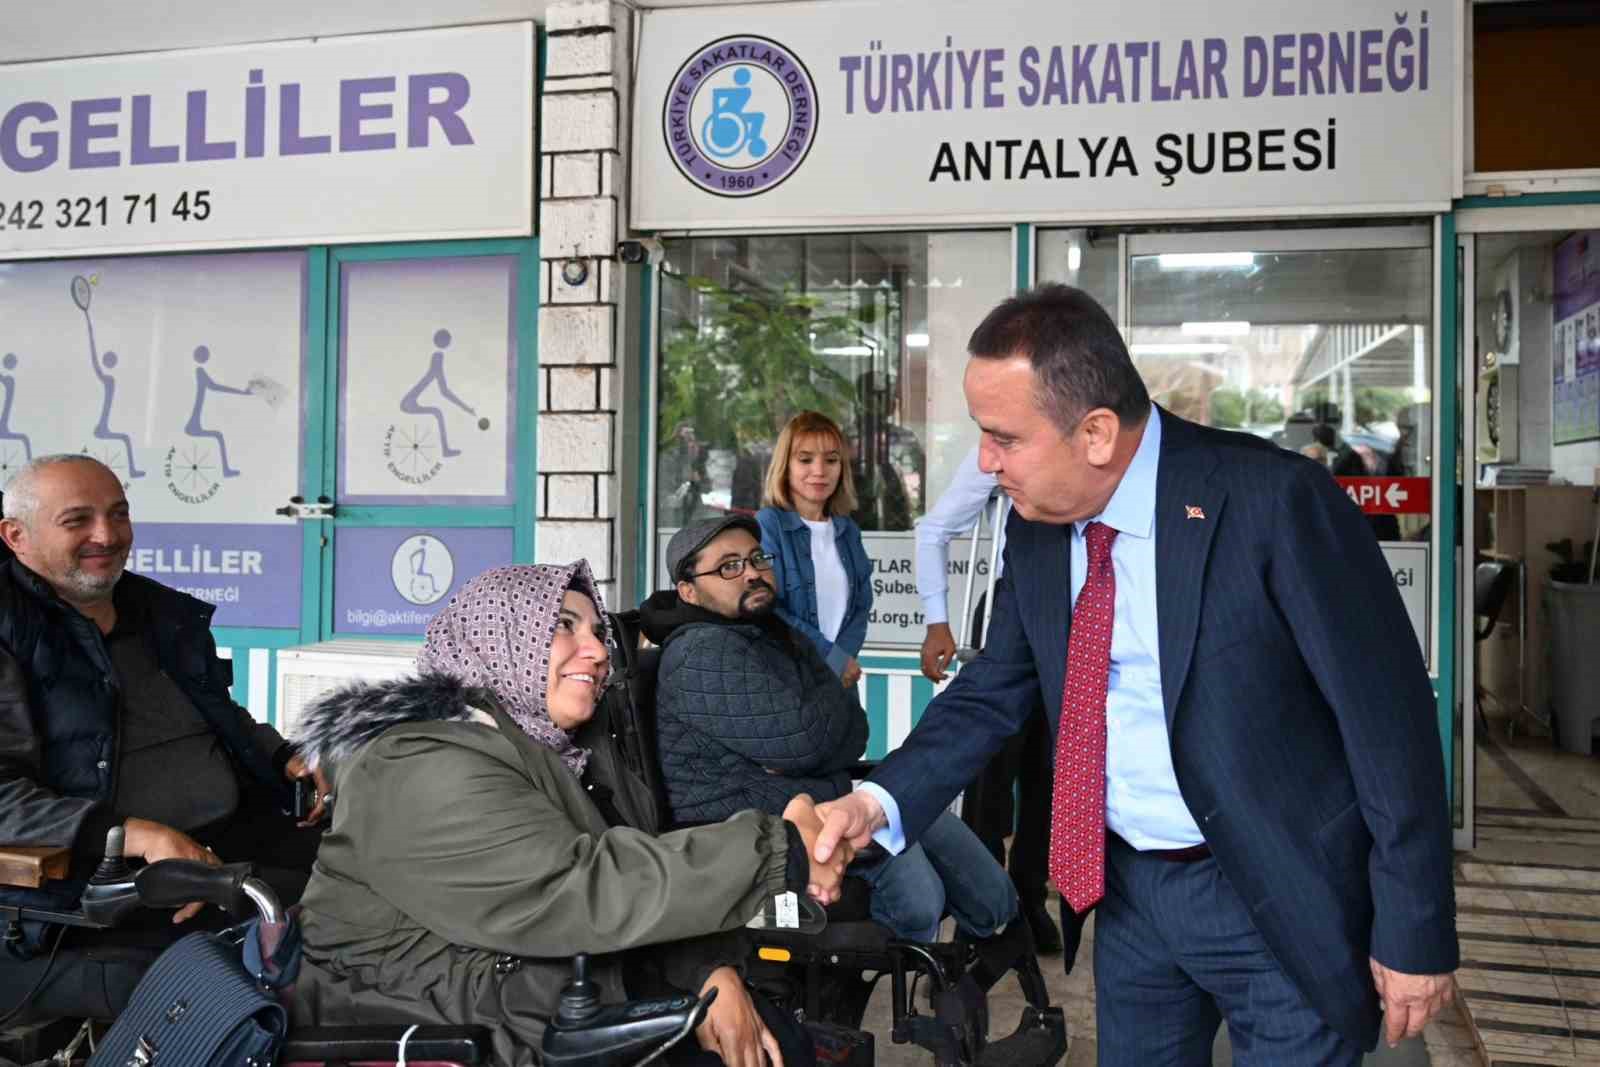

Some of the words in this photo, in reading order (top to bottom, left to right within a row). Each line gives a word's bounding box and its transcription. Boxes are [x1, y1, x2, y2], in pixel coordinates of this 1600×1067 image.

[689, 45, 787, 81] SAKATLAR
[839, 35, 1005, 114] TÜRKİYE
[1018, 38, 1228, 107] SAKATLAR
[1243, 10, 1429, 98] DERNEĞİ
[0, 69, 475, 173] GELLİLER
[929, 136, 1139, 182] ANTALYA
[1154, 118, 1336, 187] ŞUBESİ
[56, 196, 107, 228] 321
[123, 193, 157, 224] 71
[172, 190, 211, 221] 45
[720, 176, 755, 189] 1960
